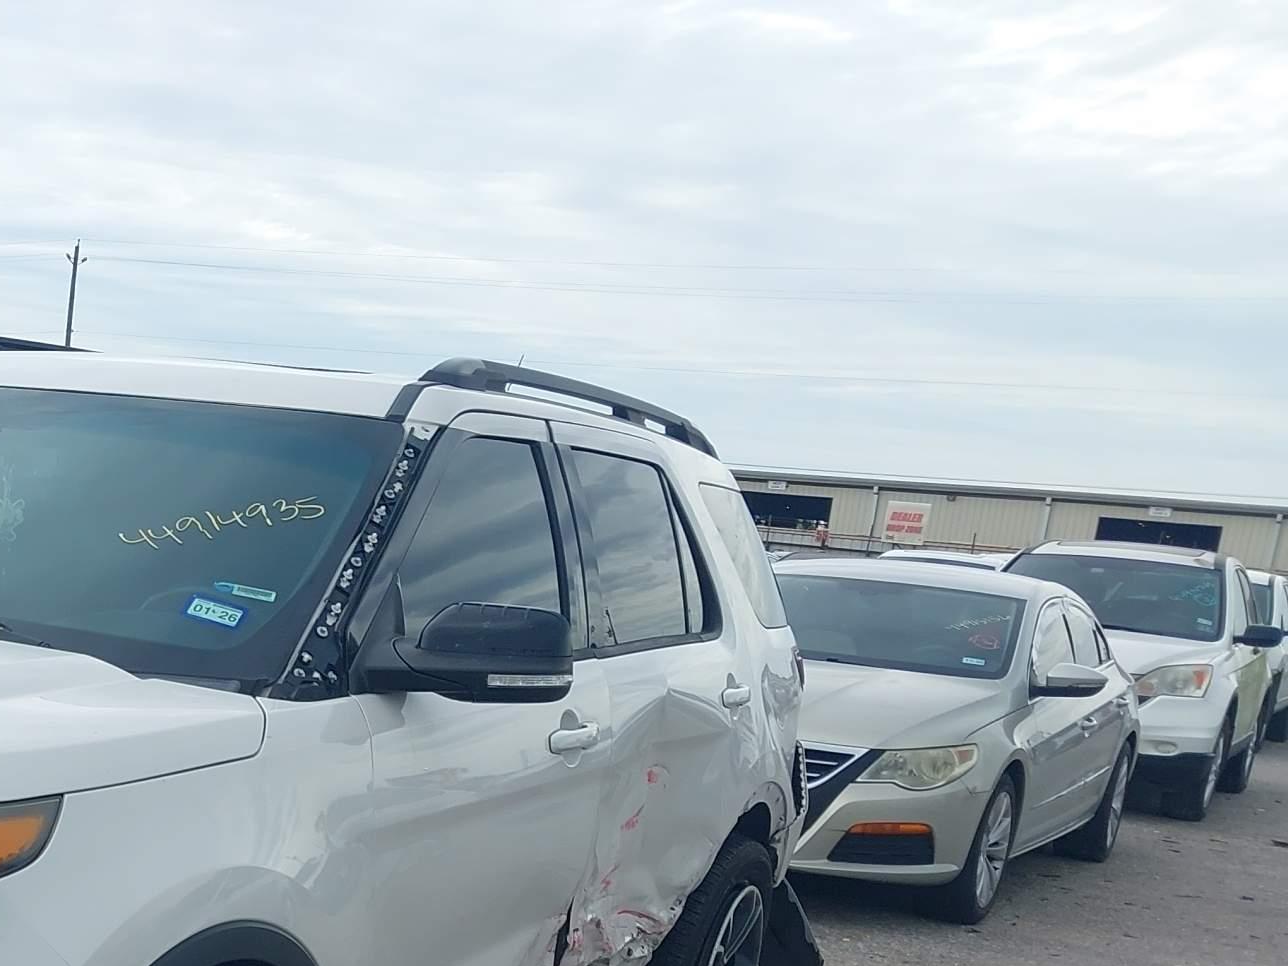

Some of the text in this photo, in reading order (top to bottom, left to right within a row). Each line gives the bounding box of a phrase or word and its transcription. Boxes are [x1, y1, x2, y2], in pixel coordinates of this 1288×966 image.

[118, 496, 325, 550] 44914935
[890, 511, 923, 522] DEALER
[217, 610, 238, 623] 26
